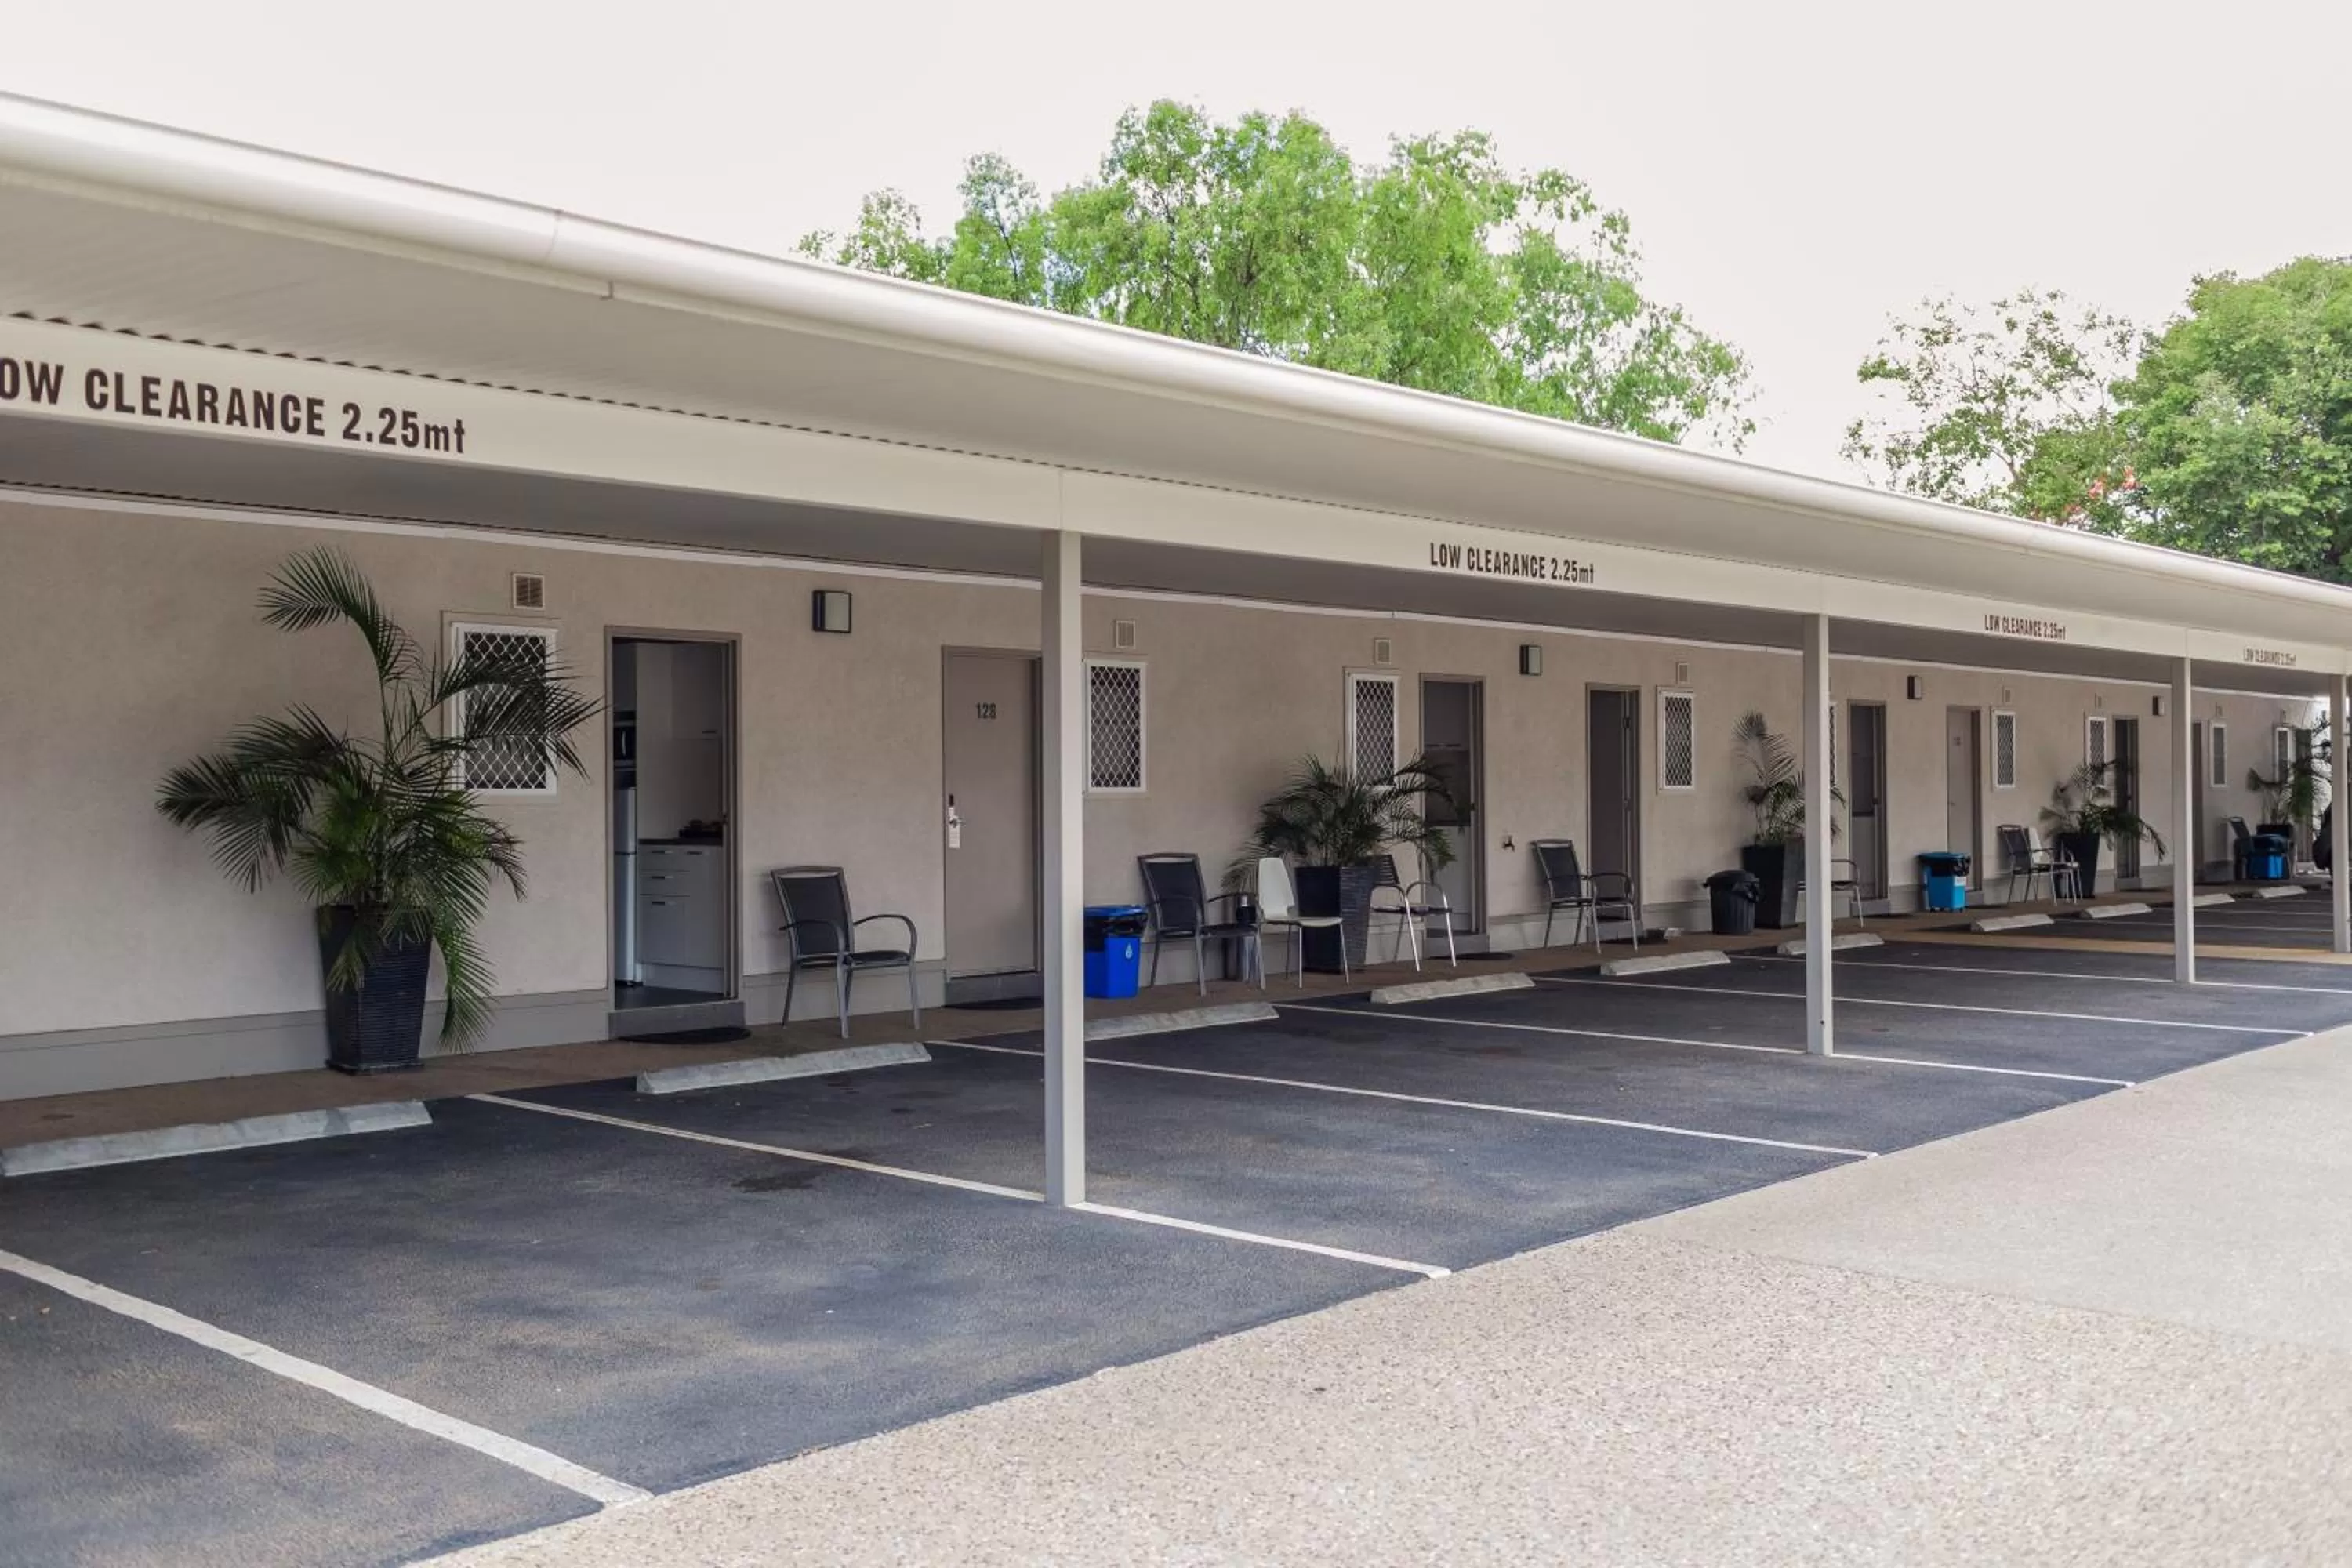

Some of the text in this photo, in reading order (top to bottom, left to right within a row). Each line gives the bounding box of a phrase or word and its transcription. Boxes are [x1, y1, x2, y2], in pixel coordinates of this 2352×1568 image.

[85, 368, 326, 437] CLEARANCE
[342, 402, 466, 454] 2.25mt
[1429, 542, 1594, 583] LOW CLEARANCE 2.25mt
[1984, 614, 2000, 632] LOW
[2002, 616, 2042, 637] CLEARANCE
